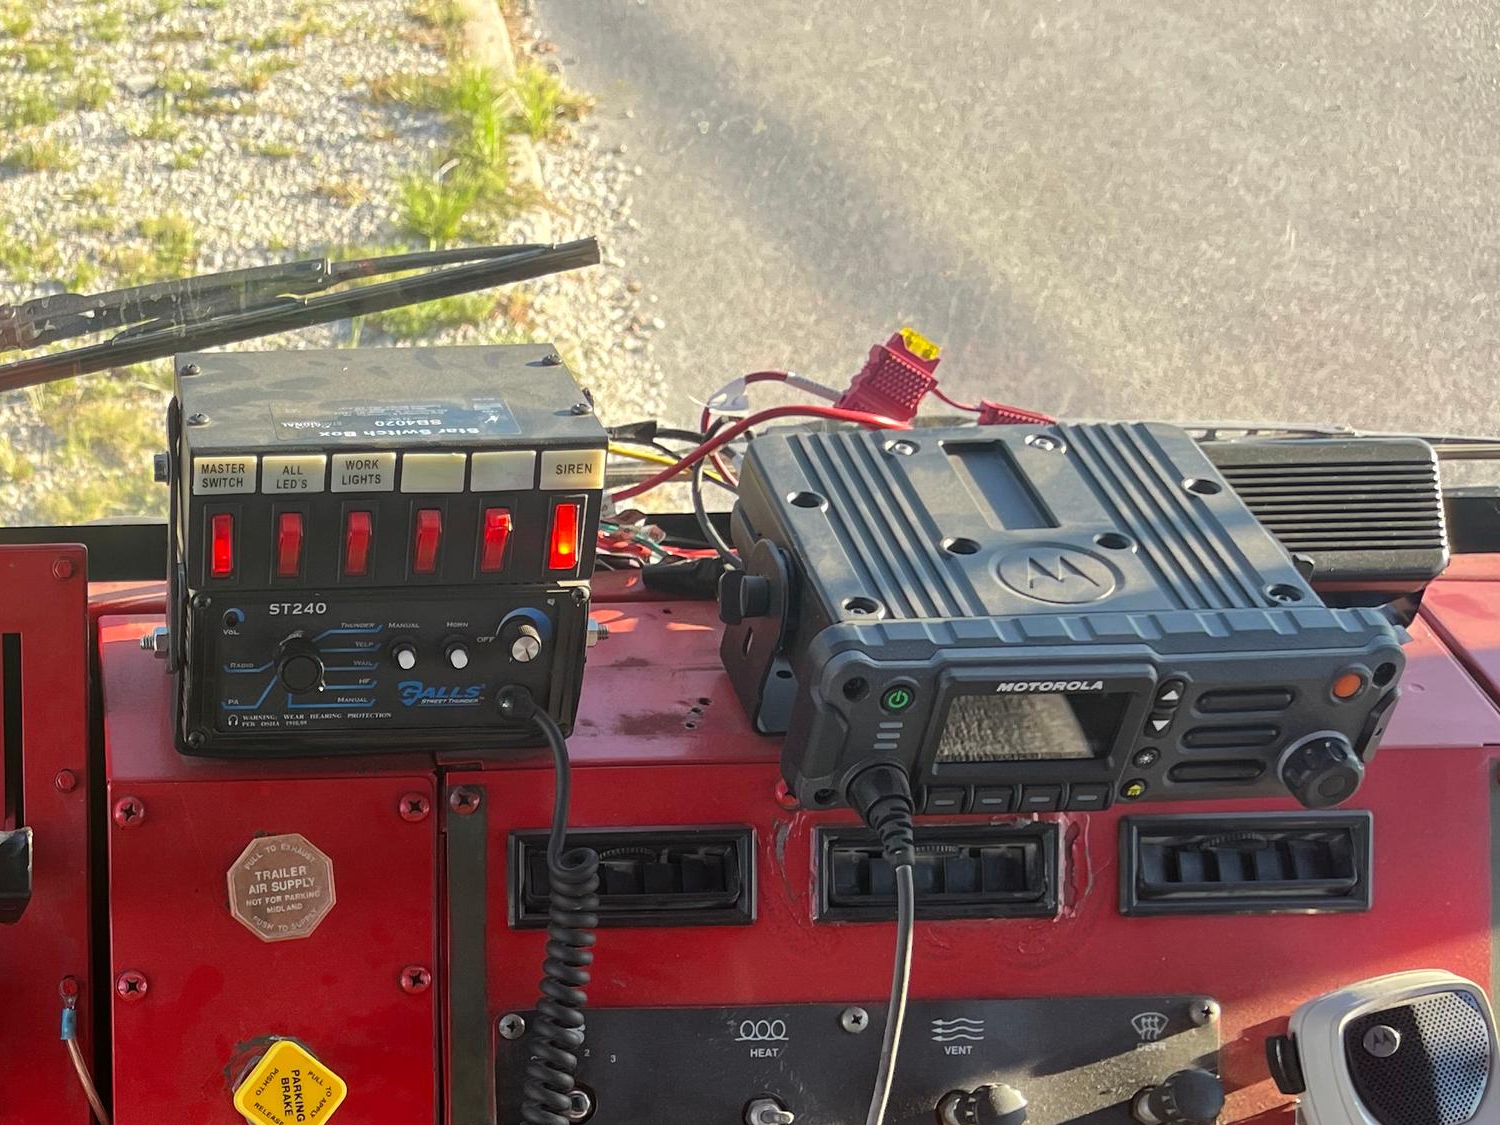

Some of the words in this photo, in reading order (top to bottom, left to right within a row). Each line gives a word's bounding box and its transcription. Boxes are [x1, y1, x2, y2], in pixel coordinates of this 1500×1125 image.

[201, 463, 245, 474] MASTER
[282, 465, 303, 475] ALL
[345, 459, 379, 471] WORK
[555, 463, 593, 475] SIREN
[202, 477, 244, 488] SWITCH
[276, 478, 308, 489] LED'S
[341, 474, 382, 485] LIGHTS
[268, 602, 327, 615] ST240
[996, 680, 1104, 692] MOTOROLA
[244, 852, 264, 870] PULL
[266, 844, 277, 853] TO
[281, 843, 317, 863] EXHAUST
[254, 865, 308, 881] TRAILER
[248, 883, 269, 895] AIR
[271, 877, 316, 892] SUPPLY
[246, 897, 262, 907] NOT
[266, 895, 282, 904] FOR
[285, 890, 321, 902] PARKING
[266, 903, 303, 914] MIDLAND
[252, 915, 275, 930] PUSH
[291, 908, 319, 930] SUPPLY
[584, 1049, 590, 1057] 2
[750, 1048, 779, 1058] HEAT
[944, 1045, 973, 1055] VENT
[610, 1055, 616, 1063] 3
[263, 1068, 279, 1086] PUSH
[307, 1071, 324, 1086] PULL
[255, 1085, 265, 1096] TO
[291, 1069, 306, 1122] PARKING
[325, 1086, 332, 1098] TO
[281, 1077, 294, 1117] BRAKE
[310, 1098, 327, 1118] APPLY
